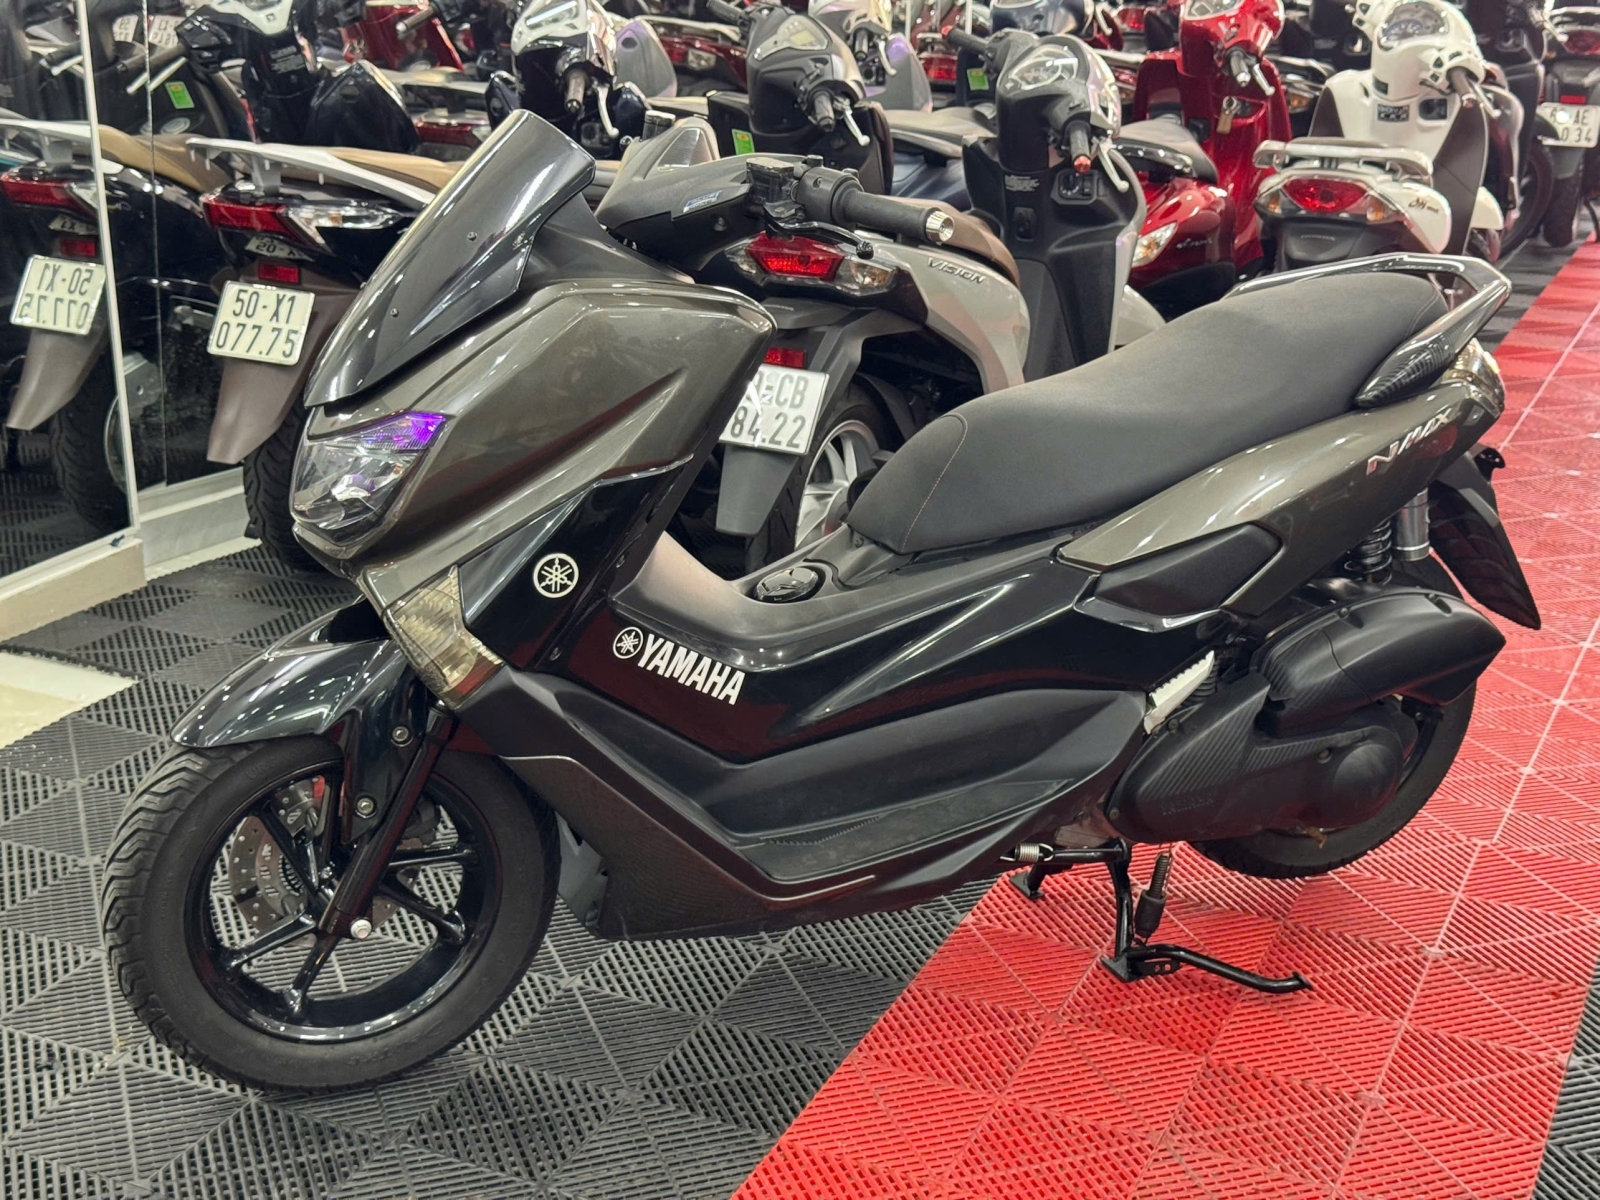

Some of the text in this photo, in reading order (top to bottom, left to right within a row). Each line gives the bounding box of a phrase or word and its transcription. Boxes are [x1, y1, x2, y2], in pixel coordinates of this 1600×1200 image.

[927, 257, 987, 284] VISION
[233, 289, 296, 325] 50-X1
[215, 321, 299, 359] 077.75
[636, 634, 746, 706] YAMAHA
